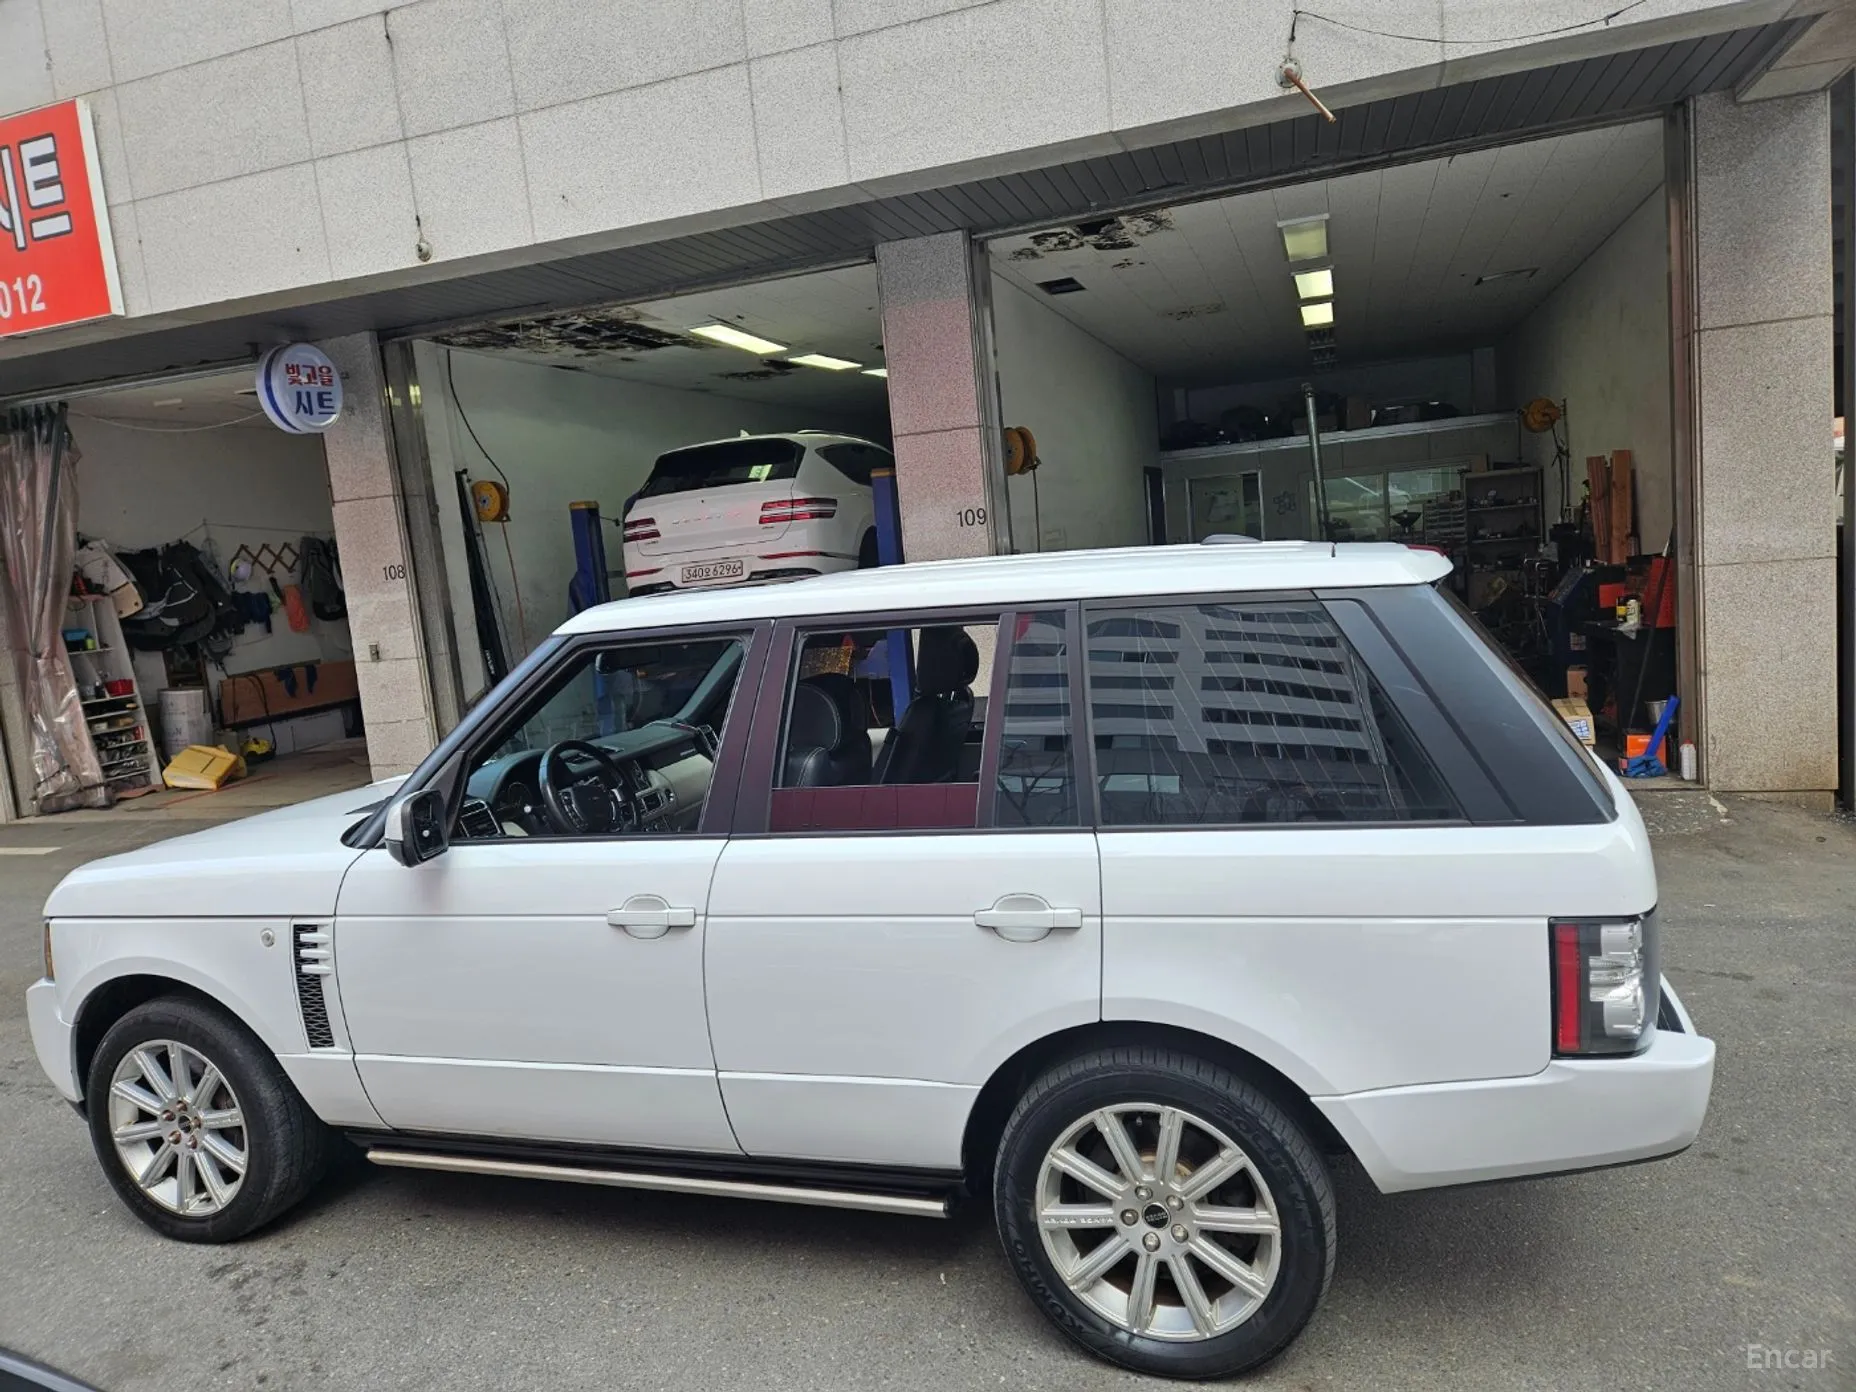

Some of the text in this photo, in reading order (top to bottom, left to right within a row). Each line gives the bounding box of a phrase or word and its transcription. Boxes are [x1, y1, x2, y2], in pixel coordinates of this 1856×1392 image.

[295, 390, 336, 416] 시트
[957, 507, 987, 528] 109
[382, 564, 406, 581] 108
[712, 563, 739, 577] 6296
